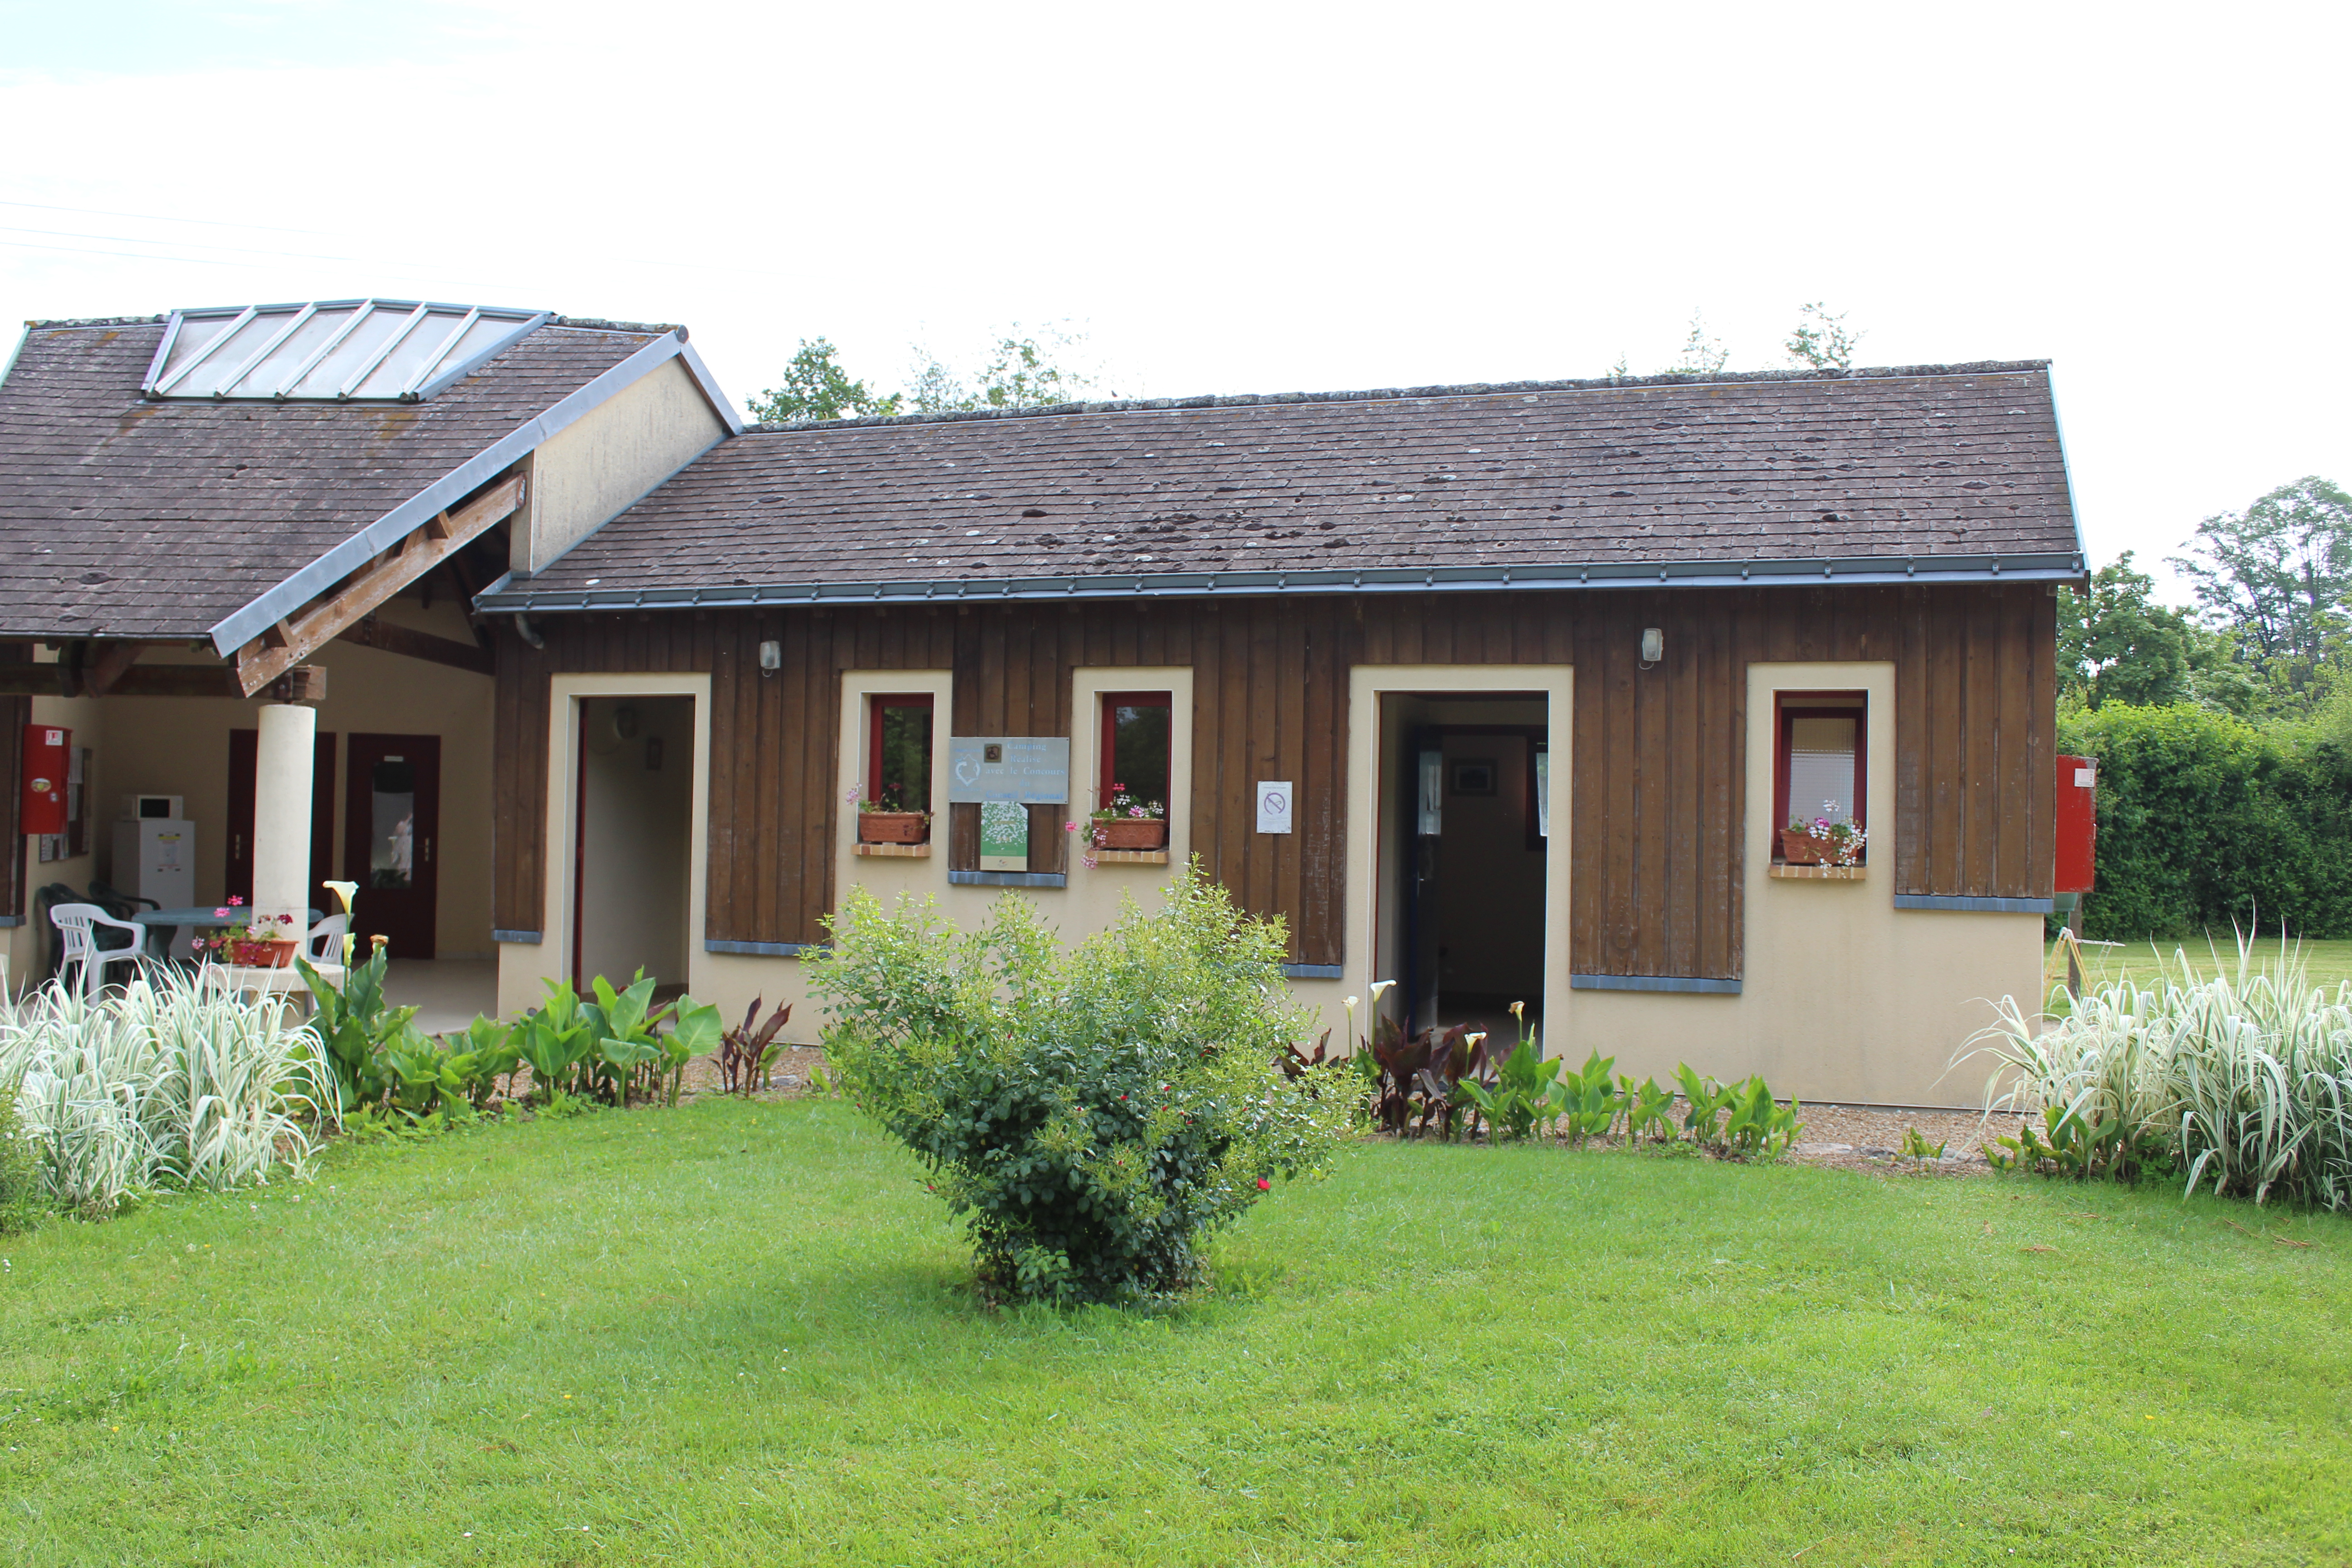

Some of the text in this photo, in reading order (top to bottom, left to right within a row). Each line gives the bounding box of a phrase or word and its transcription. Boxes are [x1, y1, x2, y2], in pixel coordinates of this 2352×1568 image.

[1007, 741, 1046, 752] Camping
[1010, 766, 1018, 774] le
[1023, 767, 1065, 775] Concours
[1019, 779, 1030, 787] du
[986, 790, 1019, 799] Conseil
